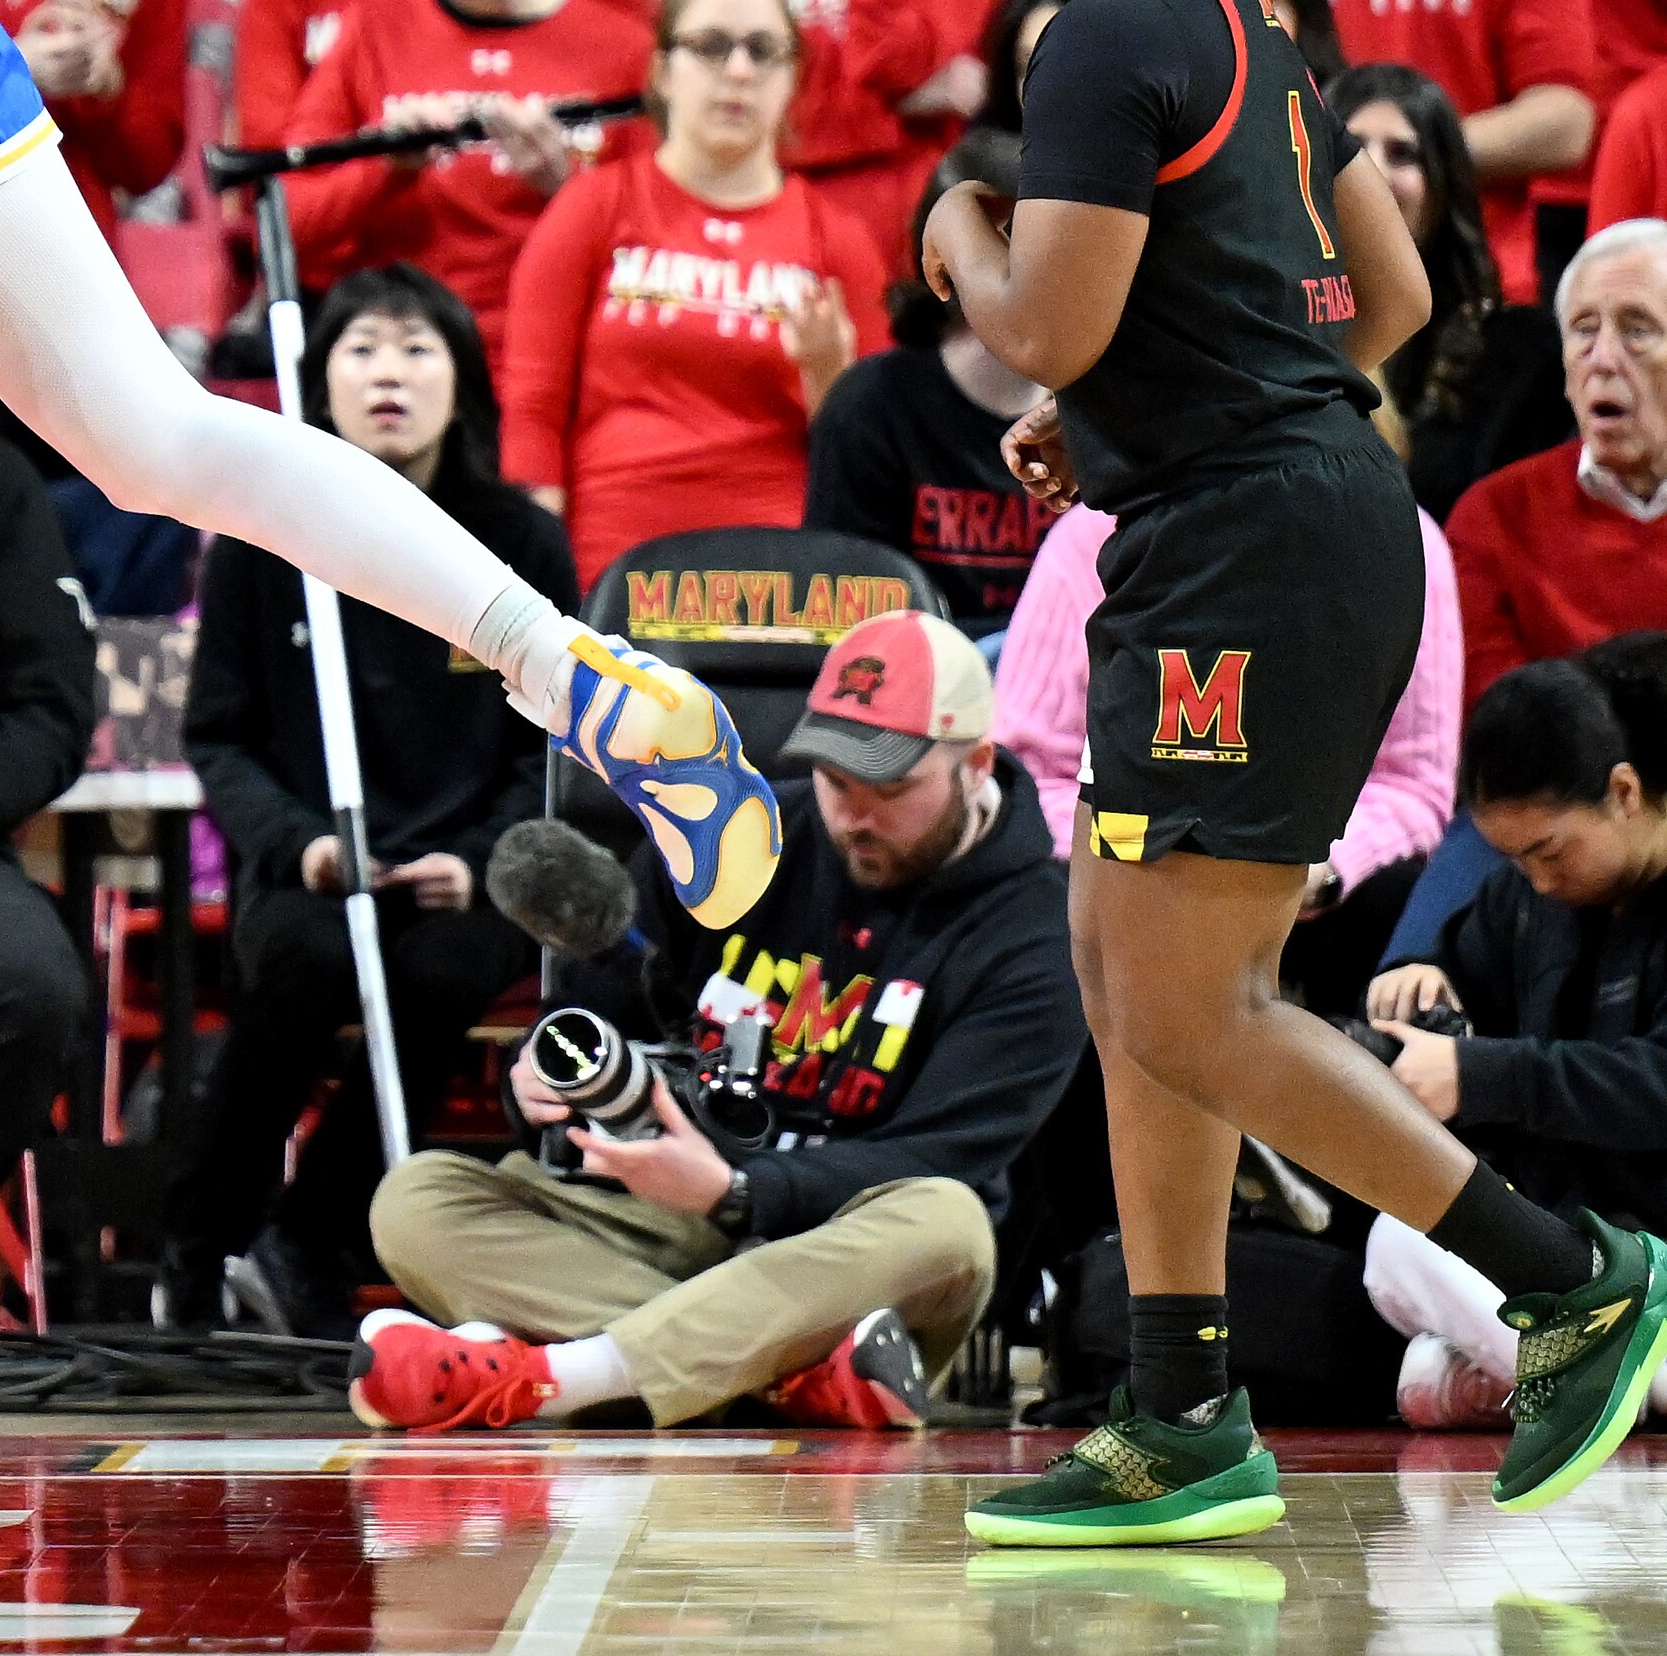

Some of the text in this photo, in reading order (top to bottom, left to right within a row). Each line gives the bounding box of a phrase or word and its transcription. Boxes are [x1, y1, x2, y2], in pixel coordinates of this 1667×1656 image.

[1288, 90, 1336, 259] 1
[626, 570, 911, 629] MARYLAND
[1152, 649, 1252, 748] M
